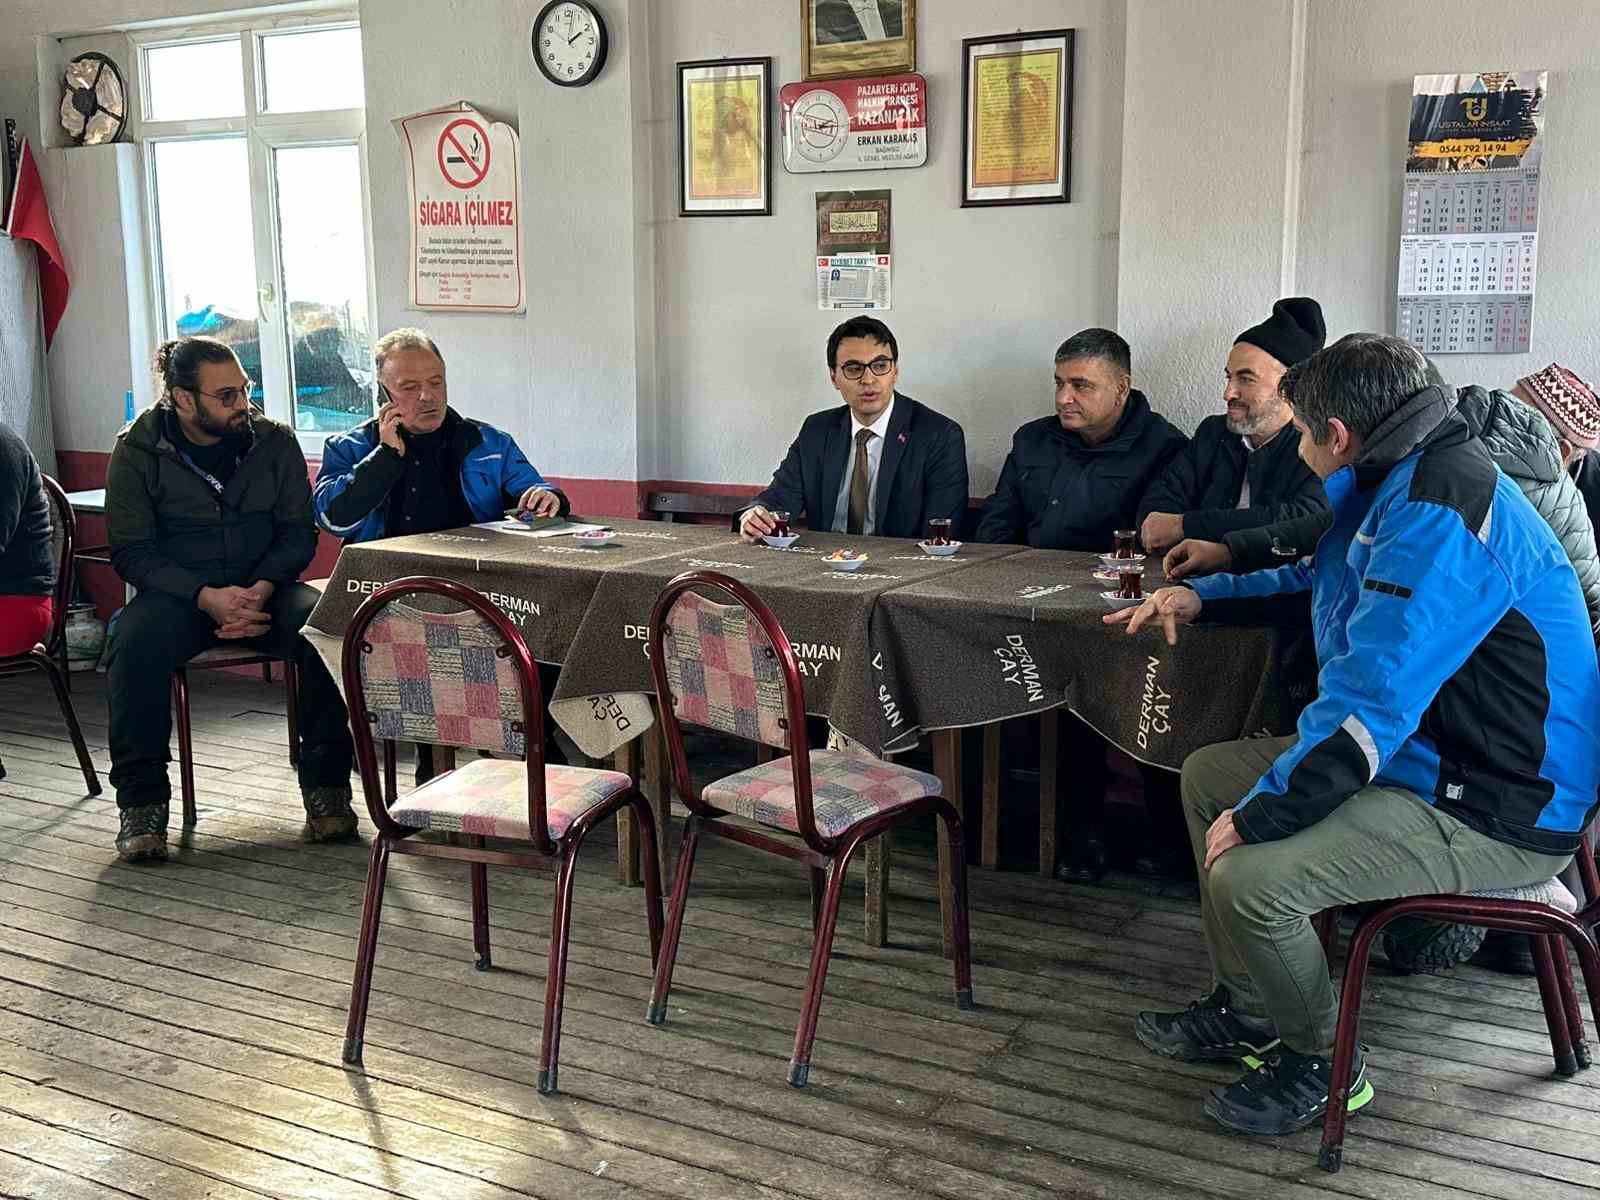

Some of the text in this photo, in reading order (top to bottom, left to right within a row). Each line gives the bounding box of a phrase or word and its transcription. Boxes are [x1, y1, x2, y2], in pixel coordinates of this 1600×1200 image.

[583, 23, 590, 32] 2
[543, 39, 551, 47] 9
[588, 37, 594, 45] 3
[548, 53, 555, 61] 8
[556, 63, 562, 72] 7
[567, 66, 574, 75] 6
[578, 62, 585, 70] 5
[857, 133, 918, 146] ERKAN KARAKAŞ
[1439, 143, 1506, 153] 0544 792 14 94
[419, 194, 514, 233] SİGARA İÇİLMEZ
[790, 642, 842, 662] RMAN
[798, 661, 823, 678] AY
[993, 647, 1022, 686] ÇAY
[1005, 634, 1045, 703] DERMAN
[1136, 655, 1161, 751] DERMAN
[1151, 685, 1172, 734] ÇAY
